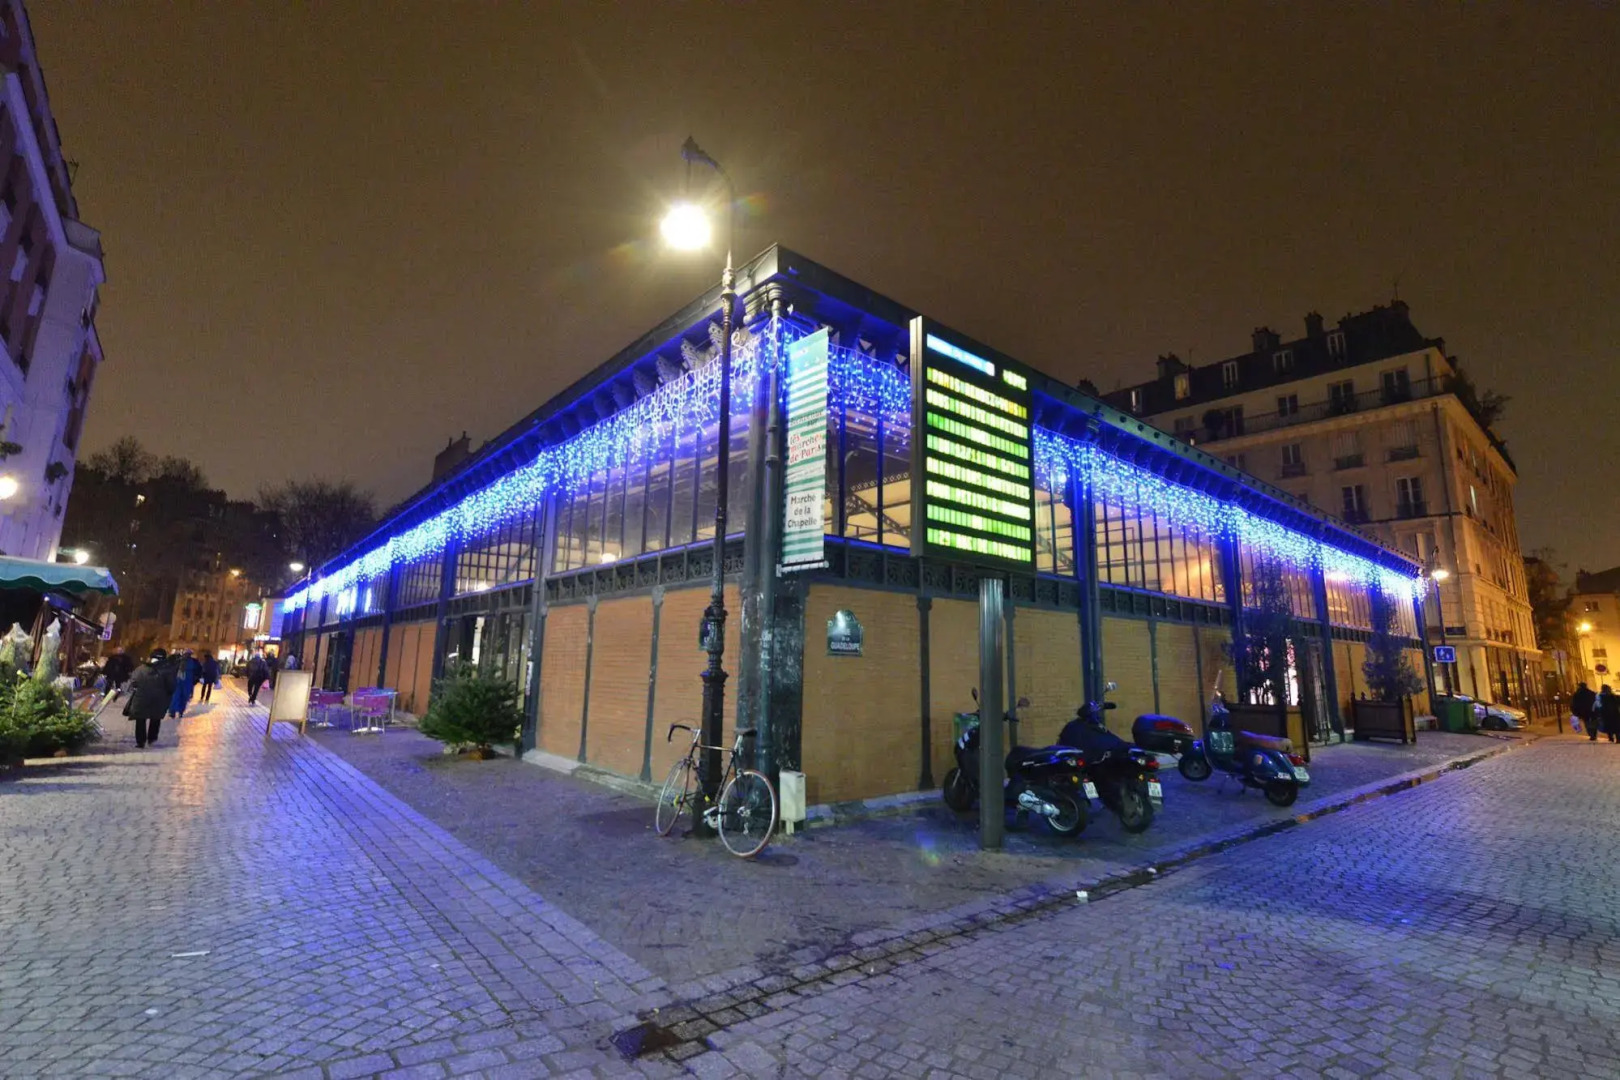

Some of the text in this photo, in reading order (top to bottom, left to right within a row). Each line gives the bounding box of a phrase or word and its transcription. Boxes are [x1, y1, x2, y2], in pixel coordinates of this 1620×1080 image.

[794, 505, 811, 516] de la
[788, 517, 817, 529] Chapelle
